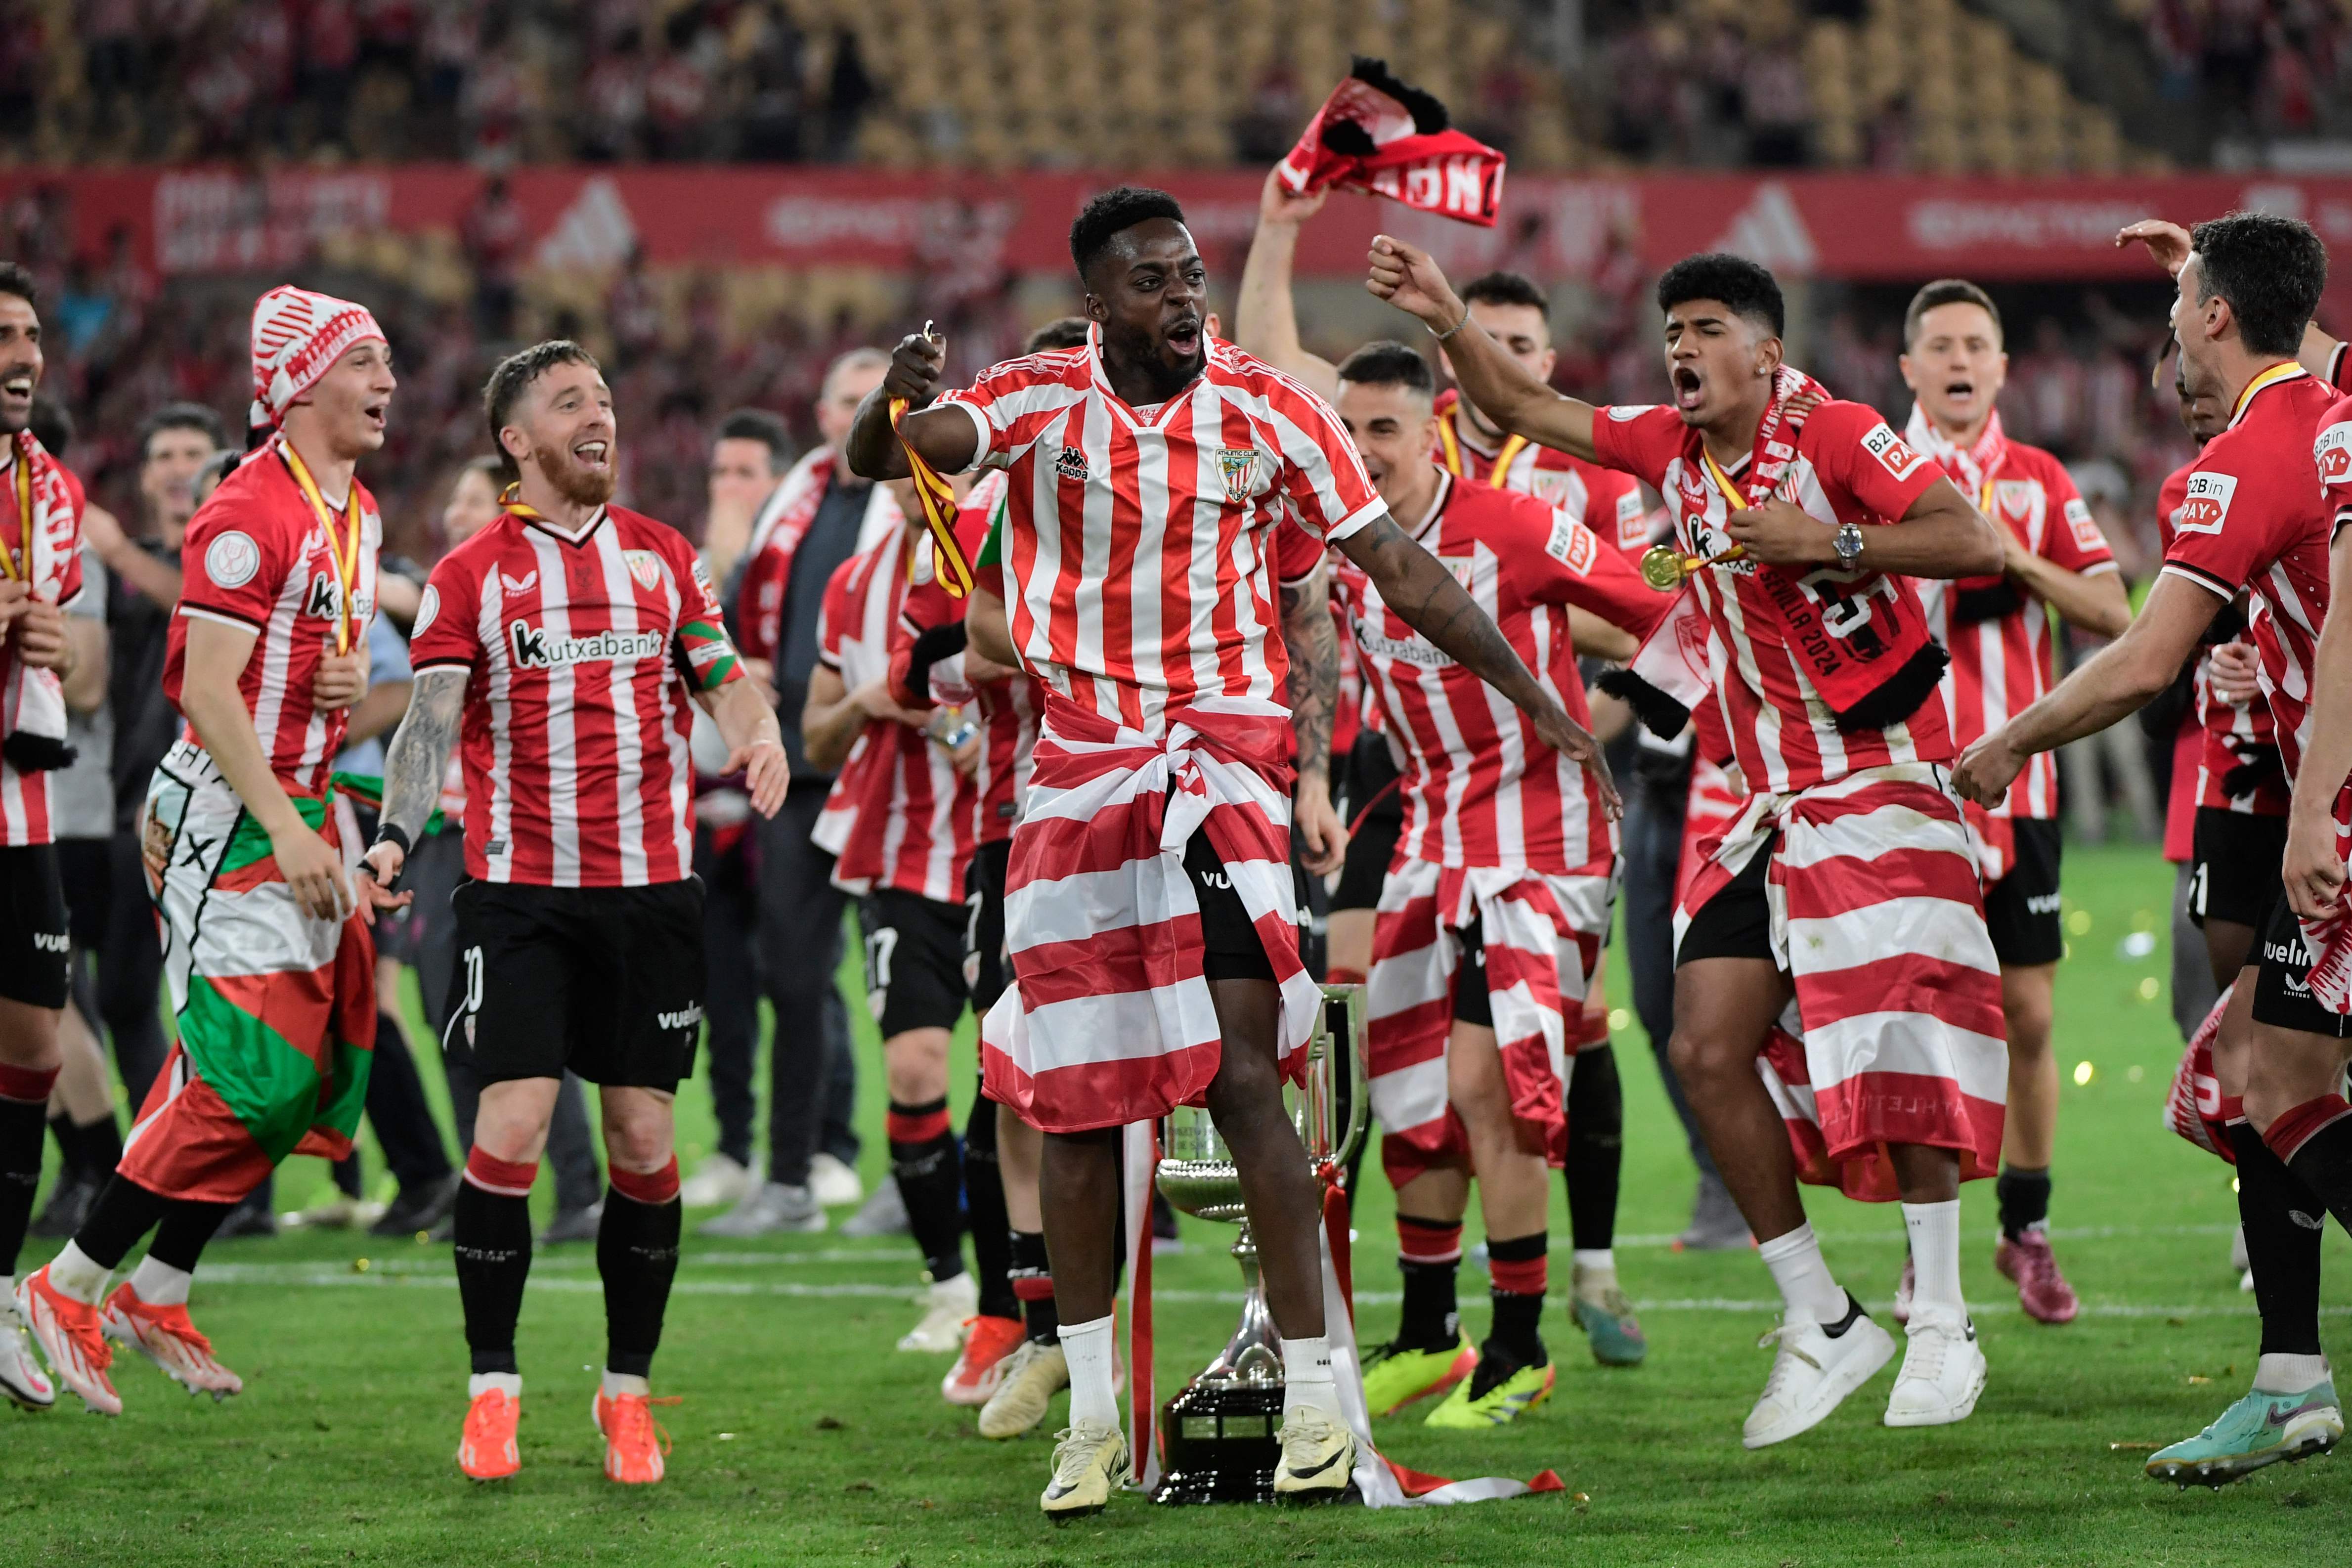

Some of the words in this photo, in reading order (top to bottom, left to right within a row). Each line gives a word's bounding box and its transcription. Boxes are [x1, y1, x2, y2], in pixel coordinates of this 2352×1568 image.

[1055, 463, 1089, 480] Kappa
[1228, 486, 1247, 501] BILBAO
[2182, 502, 2211, 520] PAY
[1759, 570, 1812, 631] SEVILLA
[1800, 630, 1842, 677] 2024
[515, 622, 661, 666] Kutxabank
[1352, 614, 1453, 665] Kutxaban
